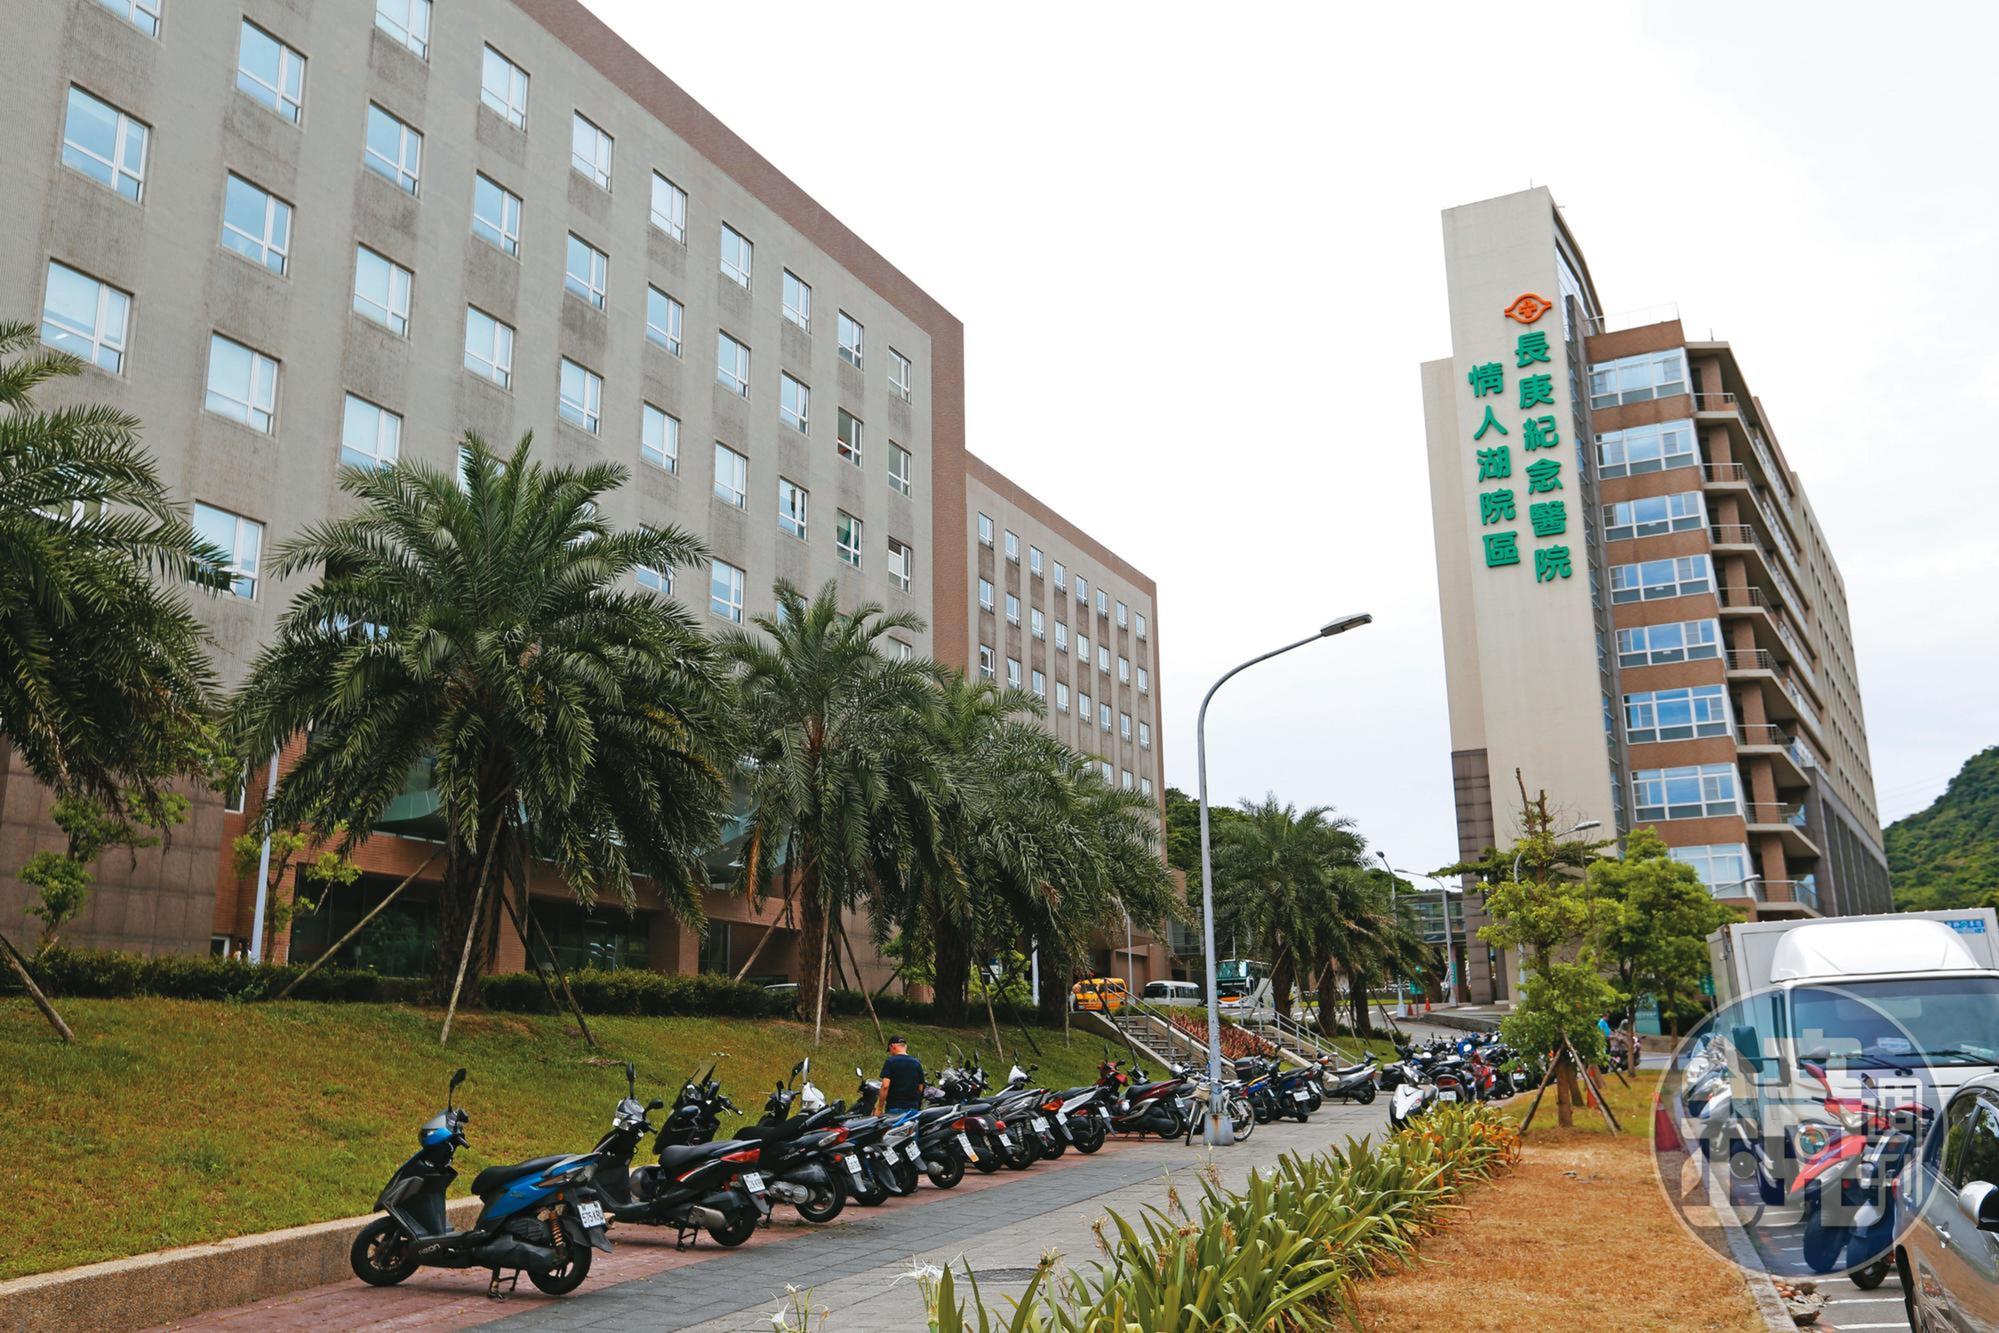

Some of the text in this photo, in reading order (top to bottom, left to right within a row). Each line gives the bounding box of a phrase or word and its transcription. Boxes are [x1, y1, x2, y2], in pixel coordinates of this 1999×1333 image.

[1468, 361, 1520, 568] 情人湖院區
[1514, 330, 1572, 583] 長庚紀念醫院
